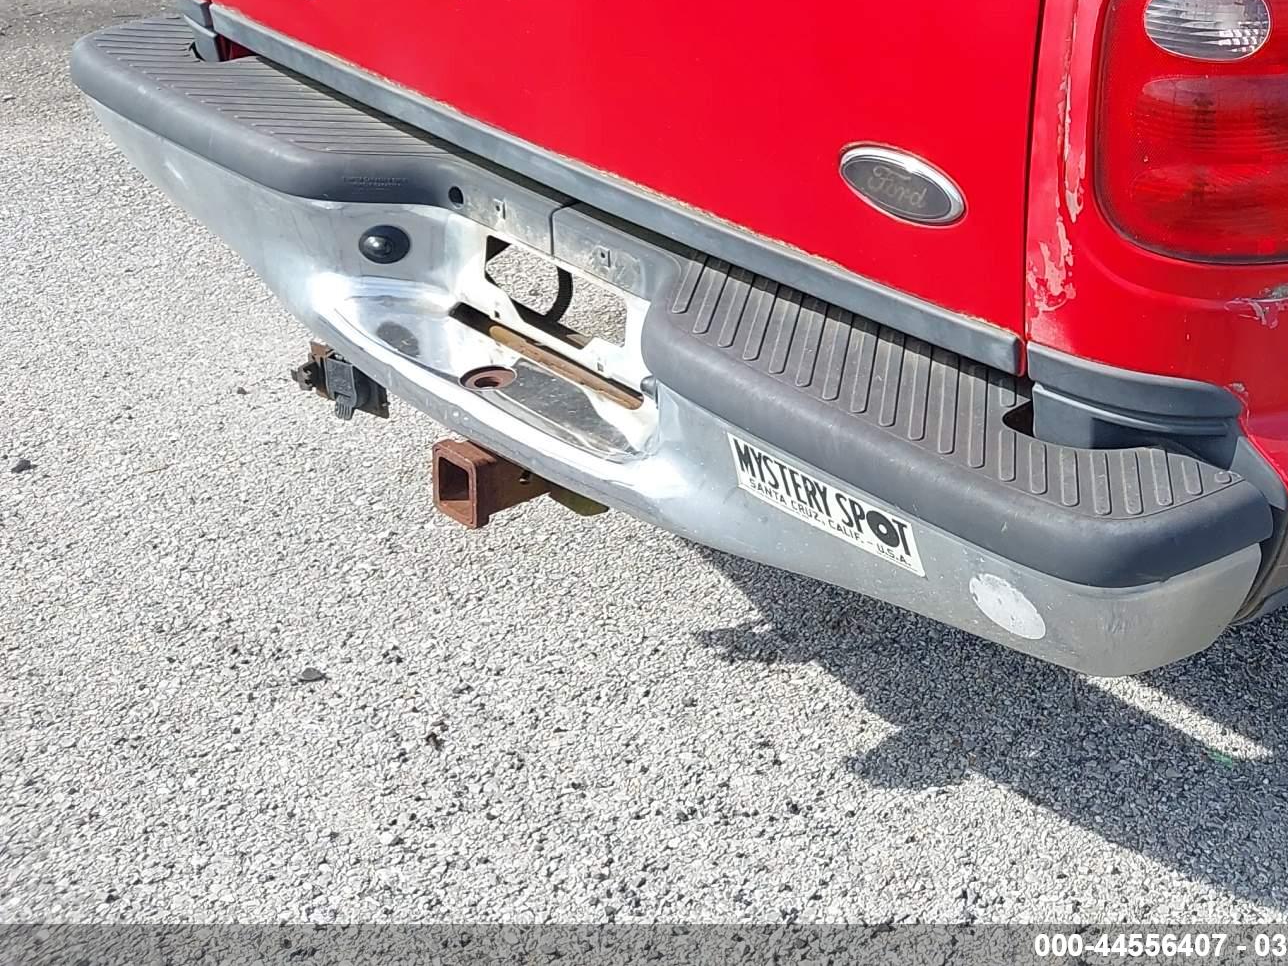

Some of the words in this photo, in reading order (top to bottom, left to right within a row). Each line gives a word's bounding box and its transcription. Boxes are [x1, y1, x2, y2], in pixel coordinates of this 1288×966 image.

[867, 164, 928, 209] Ford
[733, 437, 832, 518] MYSTERY
[835, 492, 912, 557] SPOT
[749, 478, 787, 506] SANTA
[828, 519, 865, 545] CALIF.
[876, 543, 912, 567] U.S.A.
